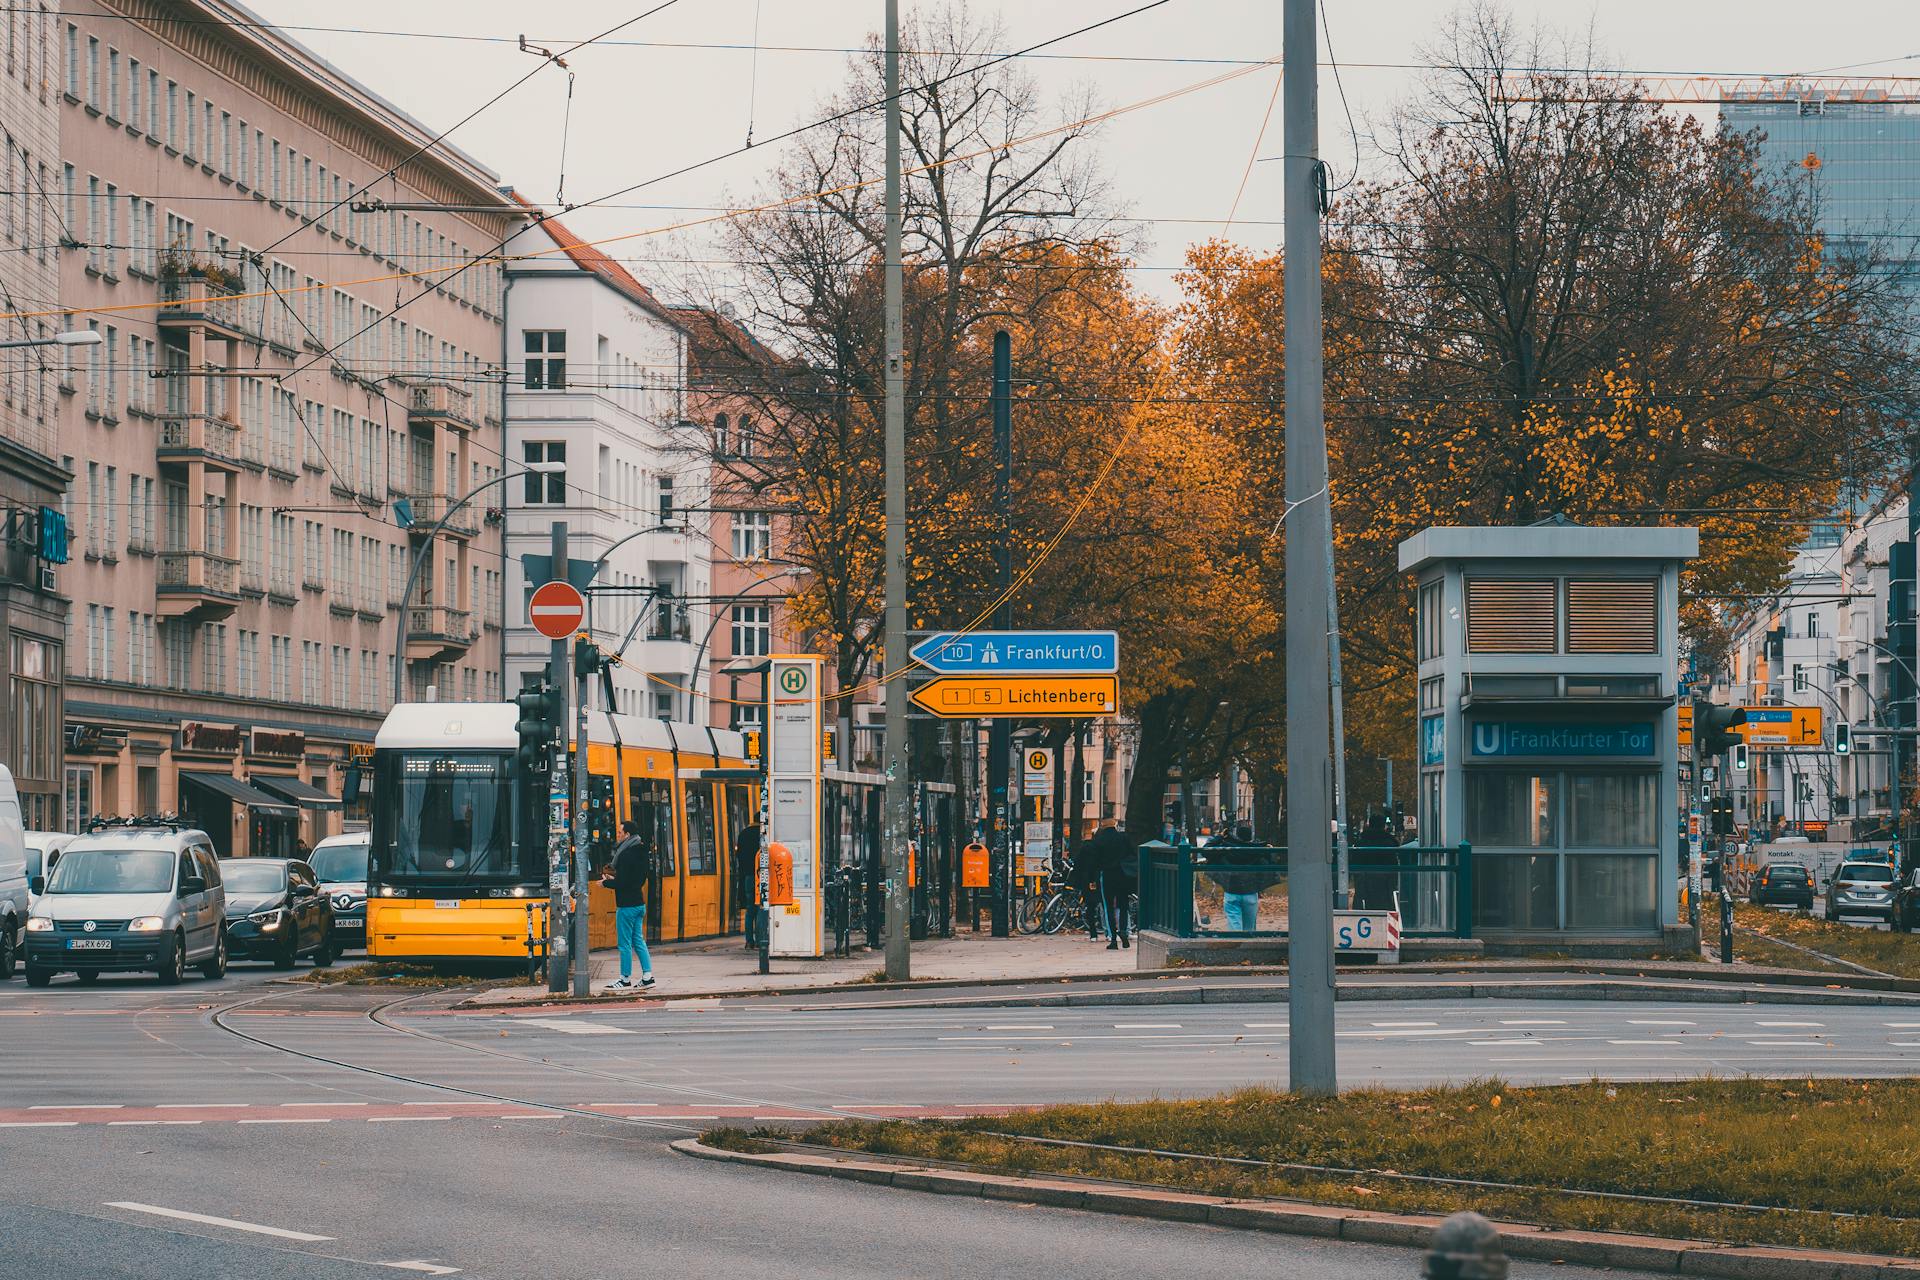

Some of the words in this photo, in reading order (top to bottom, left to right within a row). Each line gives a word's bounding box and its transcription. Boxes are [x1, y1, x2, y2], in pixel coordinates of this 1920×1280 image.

[951, 647, 963, 658] 10
[1007, 644, 1106, 660] Frankfurt/O.
[787, 673, 800, 688] H
[984, 691, 991, 702] 5
[1009, 689, 1105, 705] Lichtenberg
[1476, 725, 1499, 754] U
[1511, 729, 1614, 748] Frankfurter
[1619, 730, 1649, 748] Tor
[1034, 756, 1043, 765] H
[1339, 926, 1353, 949] S
[1357, 917, 1372, 938] G
[96, 940, 111, 948] 692
